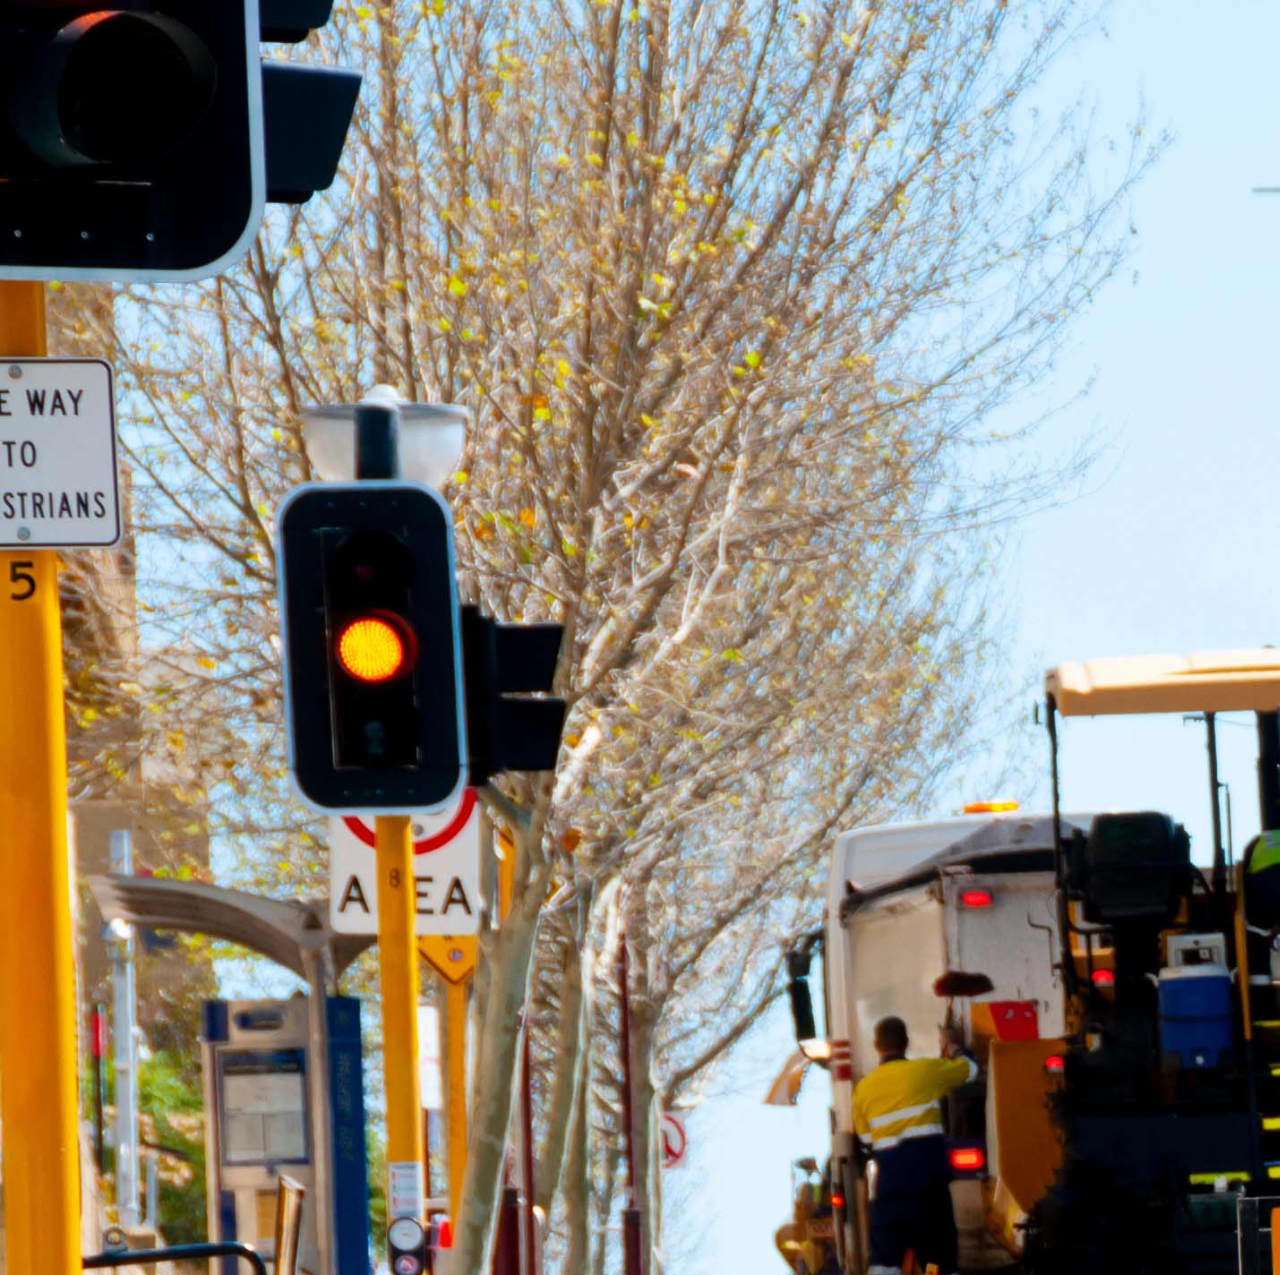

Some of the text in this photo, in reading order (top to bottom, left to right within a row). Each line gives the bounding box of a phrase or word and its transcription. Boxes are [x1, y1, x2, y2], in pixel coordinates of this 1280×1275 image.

[26, 389, 83, 416] WAY
[2, 441, 37, 468] TO
[10, 561, 36, 601] 5
[338, 874, 472, 915] AEA
